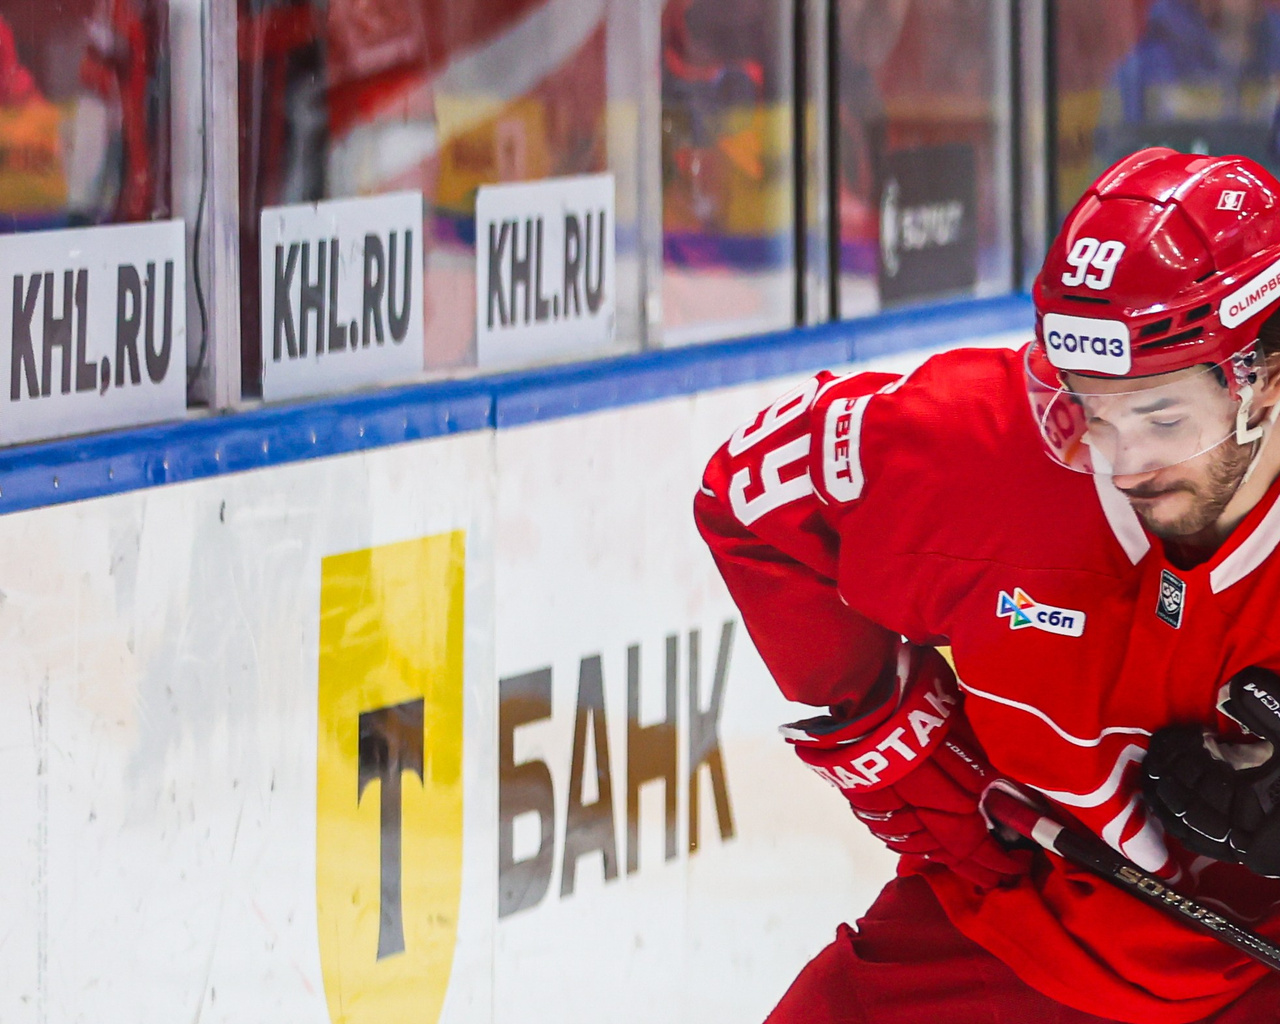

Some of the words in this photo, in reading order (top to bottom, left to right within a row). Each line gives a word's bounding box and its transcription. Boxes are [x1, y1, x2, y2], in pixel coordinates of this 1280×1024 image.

[273, 229, 413, 363] KHL.RU
[488, 211, 605, 329] KHL.RU
[1061, 237, 1126, 290] 99
[1048, 330, 1124, 358] согаз
[1036, 610, 1075, 630] сбп
[497, 618, 738, 922] БАНК
[1114, 865, 1228, 932] SOYUZ
